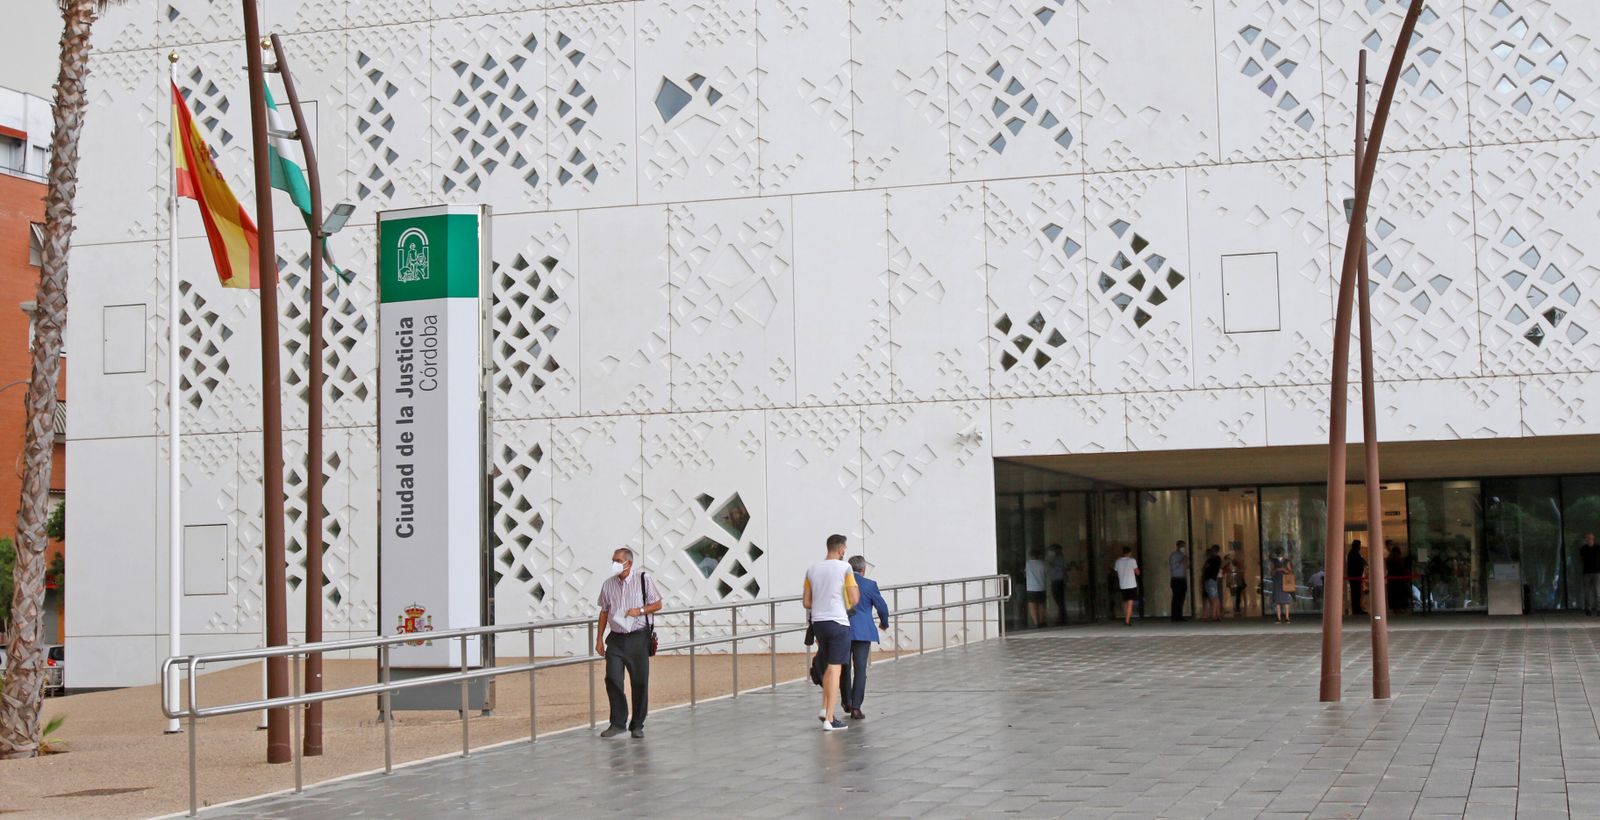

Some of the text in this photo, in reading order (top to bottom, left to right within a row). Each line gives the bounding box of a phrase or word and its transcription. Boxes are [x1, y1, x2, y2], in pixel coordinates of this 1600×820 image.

[395, 316, 415, 539] Ciudad de la Justicia
[418, 314, 438, 392] Córdoba
